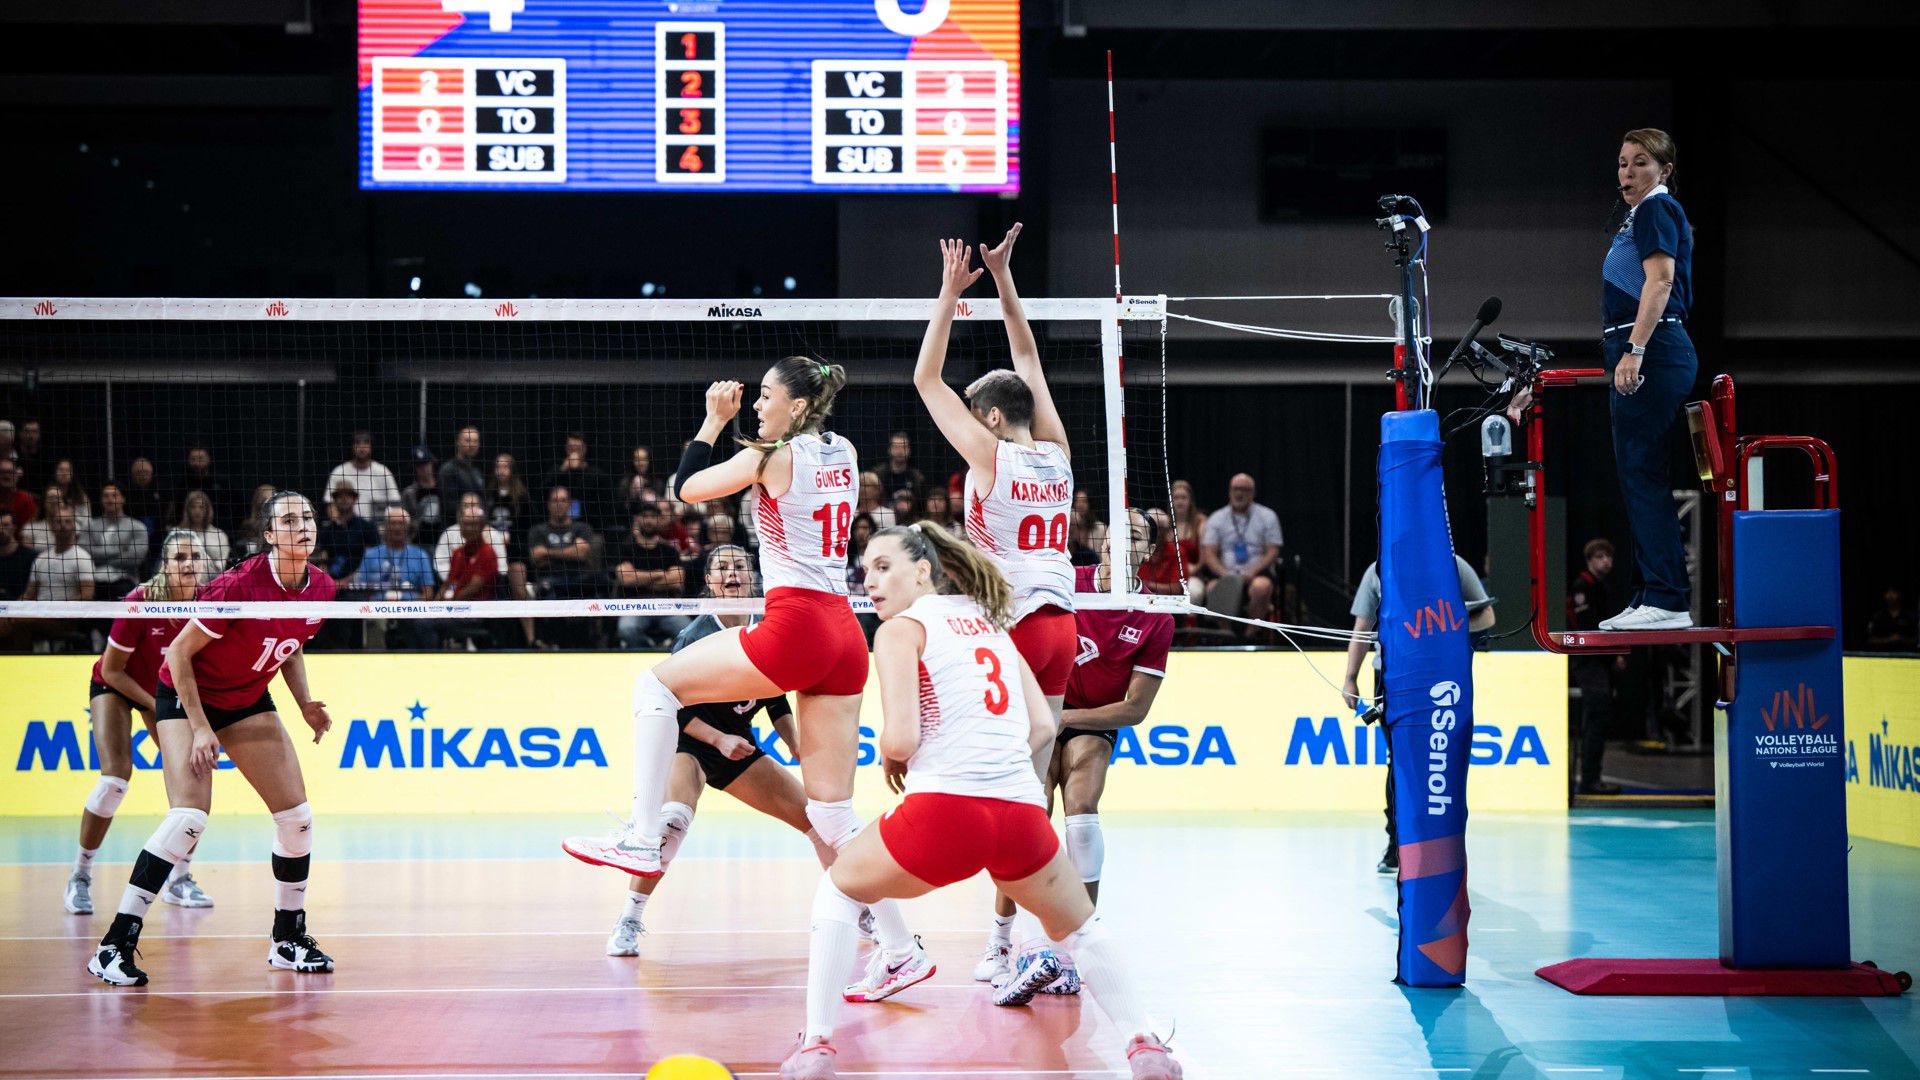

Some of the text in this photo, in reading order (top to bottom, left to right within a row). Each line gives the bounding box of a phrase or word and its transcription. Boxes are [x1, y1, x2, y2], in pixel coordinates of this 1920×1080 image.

[681, 32, 697, 59] 1
[419, 70, 536, 96] 2 VC
[681, 70, 703, 98] 2
[844, 71, 965, 97] VC 2
[417, 108, 536, 133] 0 TO
[679, 108, 702, 134] 3
[845, 109, 966, 135] TO 0
[417, 146, 545, 171] 0 SUB
[679, 145, 703, 172] 4
[837, 146, 966, 173] SUB 0
[34, 300, 58, 317] VNL
[265, 301, 289, 318] VNL
[495, 302, 519, 318] VNL
[956, 301, 973, 317] NL
[812, 501, 851, 558] 18
[144, 605, 198, 614] VOLLEYBALL
[604, 602, 657, 611] VOLLEYBALL
[1404, 598, 1464, 639] VNL
[251, 637, 300, 672] 19
[975, 647, 1009, 715] 3
[1761, 682, 1829, 732] VNL
[1110, 725, 1237, 766] ASA
[1284, 716, 1551, 766] MISA
[1755, 734, 1838, 746] VOLLEYBALL
[1755, 745, 1838, 755] NATIONS LEAGUE
[1428, 709, 1456, 816] Senoh
[1778, 761, 1805, 769] Volleyball
